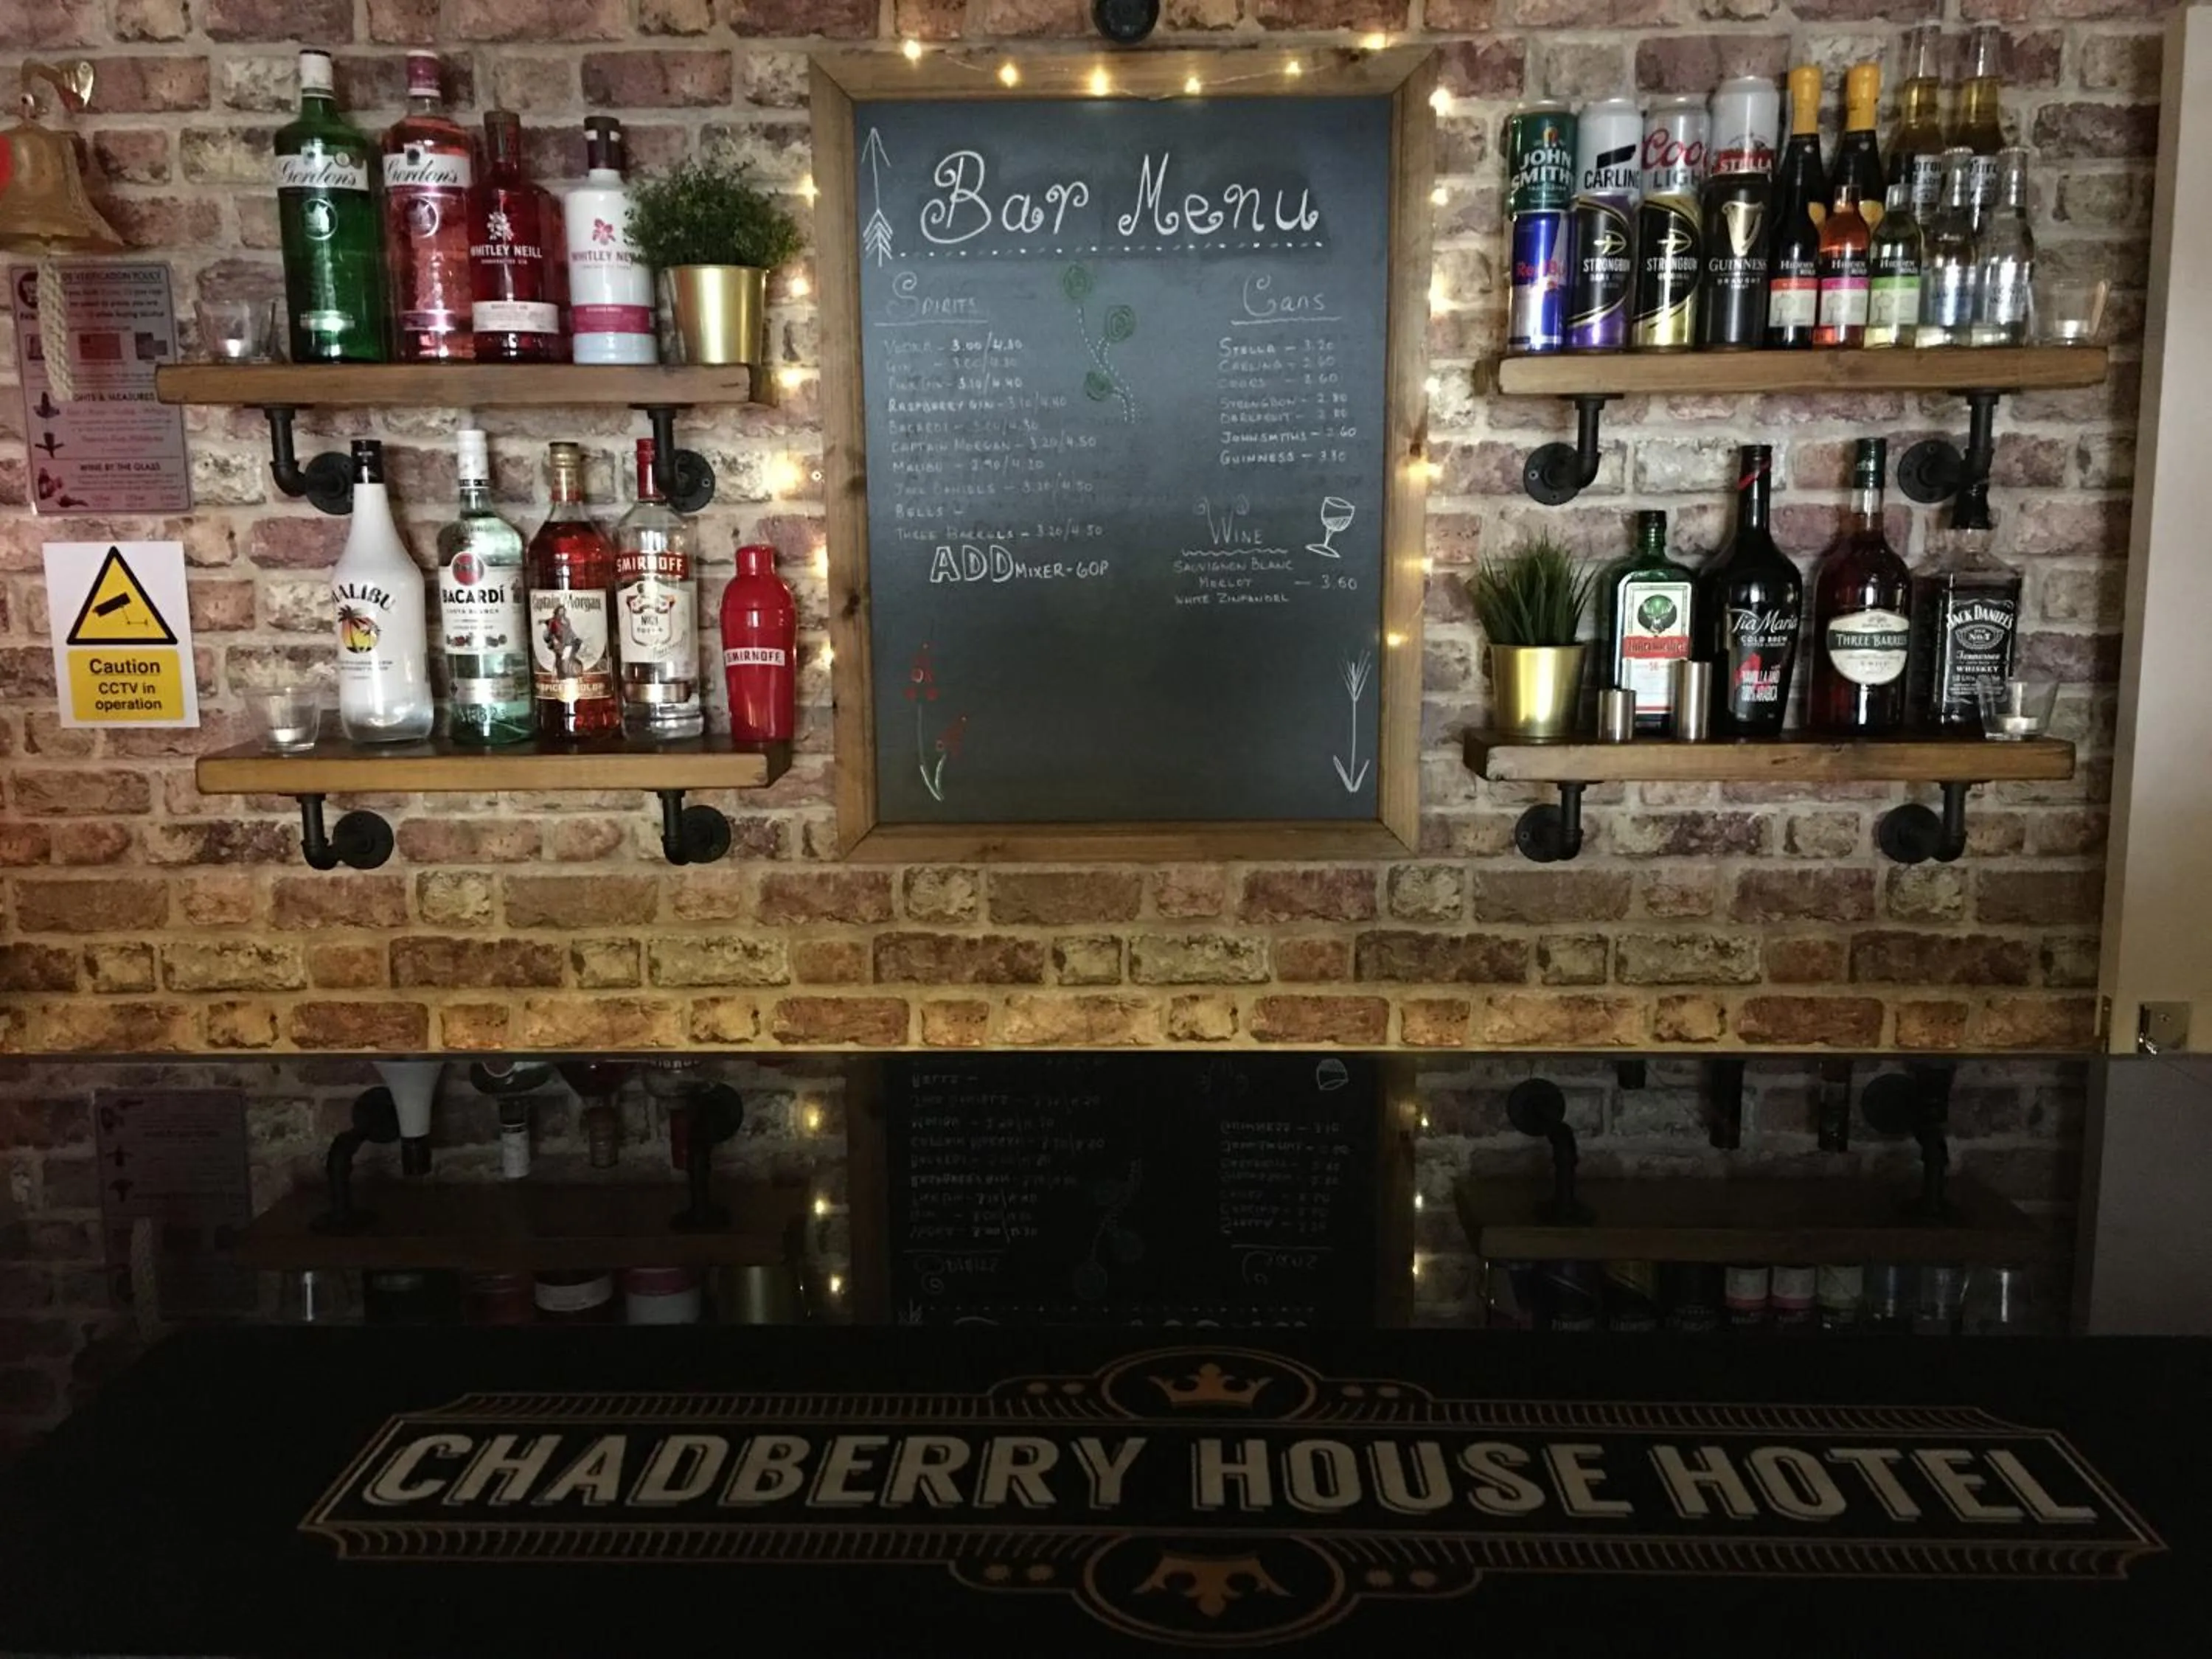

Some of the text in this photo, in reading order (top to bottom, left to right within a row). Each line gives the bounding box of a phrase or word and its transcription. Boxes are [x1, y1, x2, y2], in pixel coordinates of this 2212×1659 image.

[1520, 148, 1572, 170] JOHN
[1719, 158, 1771, 173] STELLA
[282, 161, 357, 186] Gordon's
[387, 159, 458, 184] Gordon's
[1653, 169, 1700, 188] LIGH
[921, 150, 1320, 244] Bar Menu
[470, 244, 543, 259] WHITLEY NEILL
[571, 250, 612, 262] WHITLEY
[1708, 258, 1767, 272] GUINNESS
[1242, 271, 1326, 317] Cans
[1219, 337, 1276, 357] STELLA
[888, 397, 964, 413] RASPBERRY
[969, 400, 993, 410] GIN
[1220, 396, 1298, 409] STRONGBOW
[891, 440, 948, 453] CAPTAIN
[954, 438, 1011, 452] MORGAN
[1220, 450, 1295, 465] GUINNESS
[893, 461, 943, 473] MALIBU
[895, 504, 944, 519] BELLS
[1192, 493, 1264, 546] WINE
[896, 527, 939, 540] THREE
[930, 545, 1014, 583] ADD
[1251, 558, 1294, 571] BLANC
[1199, 576, 1252, 588] MERLOT
[442, 585, 504, 604] BACARDÍ
[1175, 592, 1290, 605] WHITE ZINFANDEL
[1728, 608, 1797, 635] Tia Maria
[1946, 608, 1973, 630] JACK
[1741, 635, 1765, 643] COLD
[1836, 633, 1868, 647] THREE
[726, 650, 782, 664] SMIRNOFF
[89, 658, 161, 674] Caution
[98, 681, 156, 695] CCTV in
[95, 698, 162, 712] operation
[362, 1433, 2098, 1523] CHADBERRY HOUSE HOTEL
